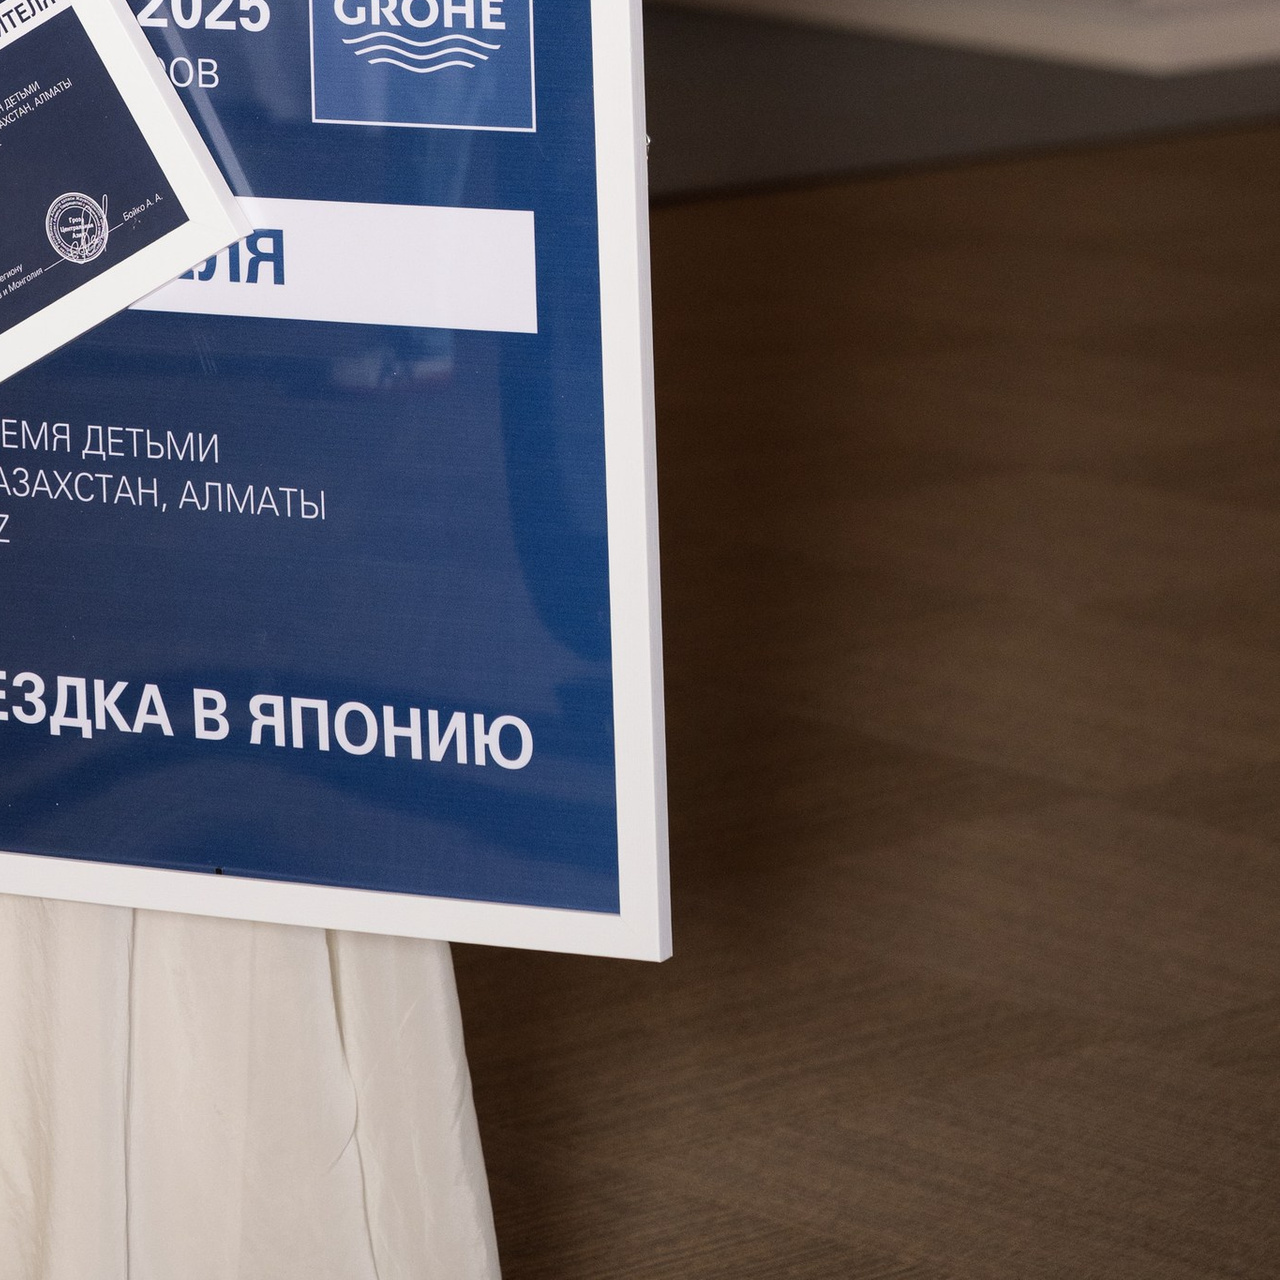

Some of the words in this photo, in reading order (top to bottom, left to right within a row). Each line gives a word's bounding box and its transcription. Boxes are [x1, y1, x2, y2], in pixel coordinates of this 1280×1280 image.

[3, 80, 41, 111] ДЕТЬМИ
[34, 77, 73, 108] АЛМАТЫ
[122, 204, 146, 222] Бойко
[146, 198, 155, 209] А.
[155, 193, 164, 203] А.
[2, 288, 9, 296] и
[7, 267, 44, 293] Монголия
[82, 426, 218, 463] ДЕТЬМИ
[179, 481, 325, 519] АЛМАТЫ
[194, 688, 229, 740] В
[249, 695, 533, 769] ЯПОНИЮ
